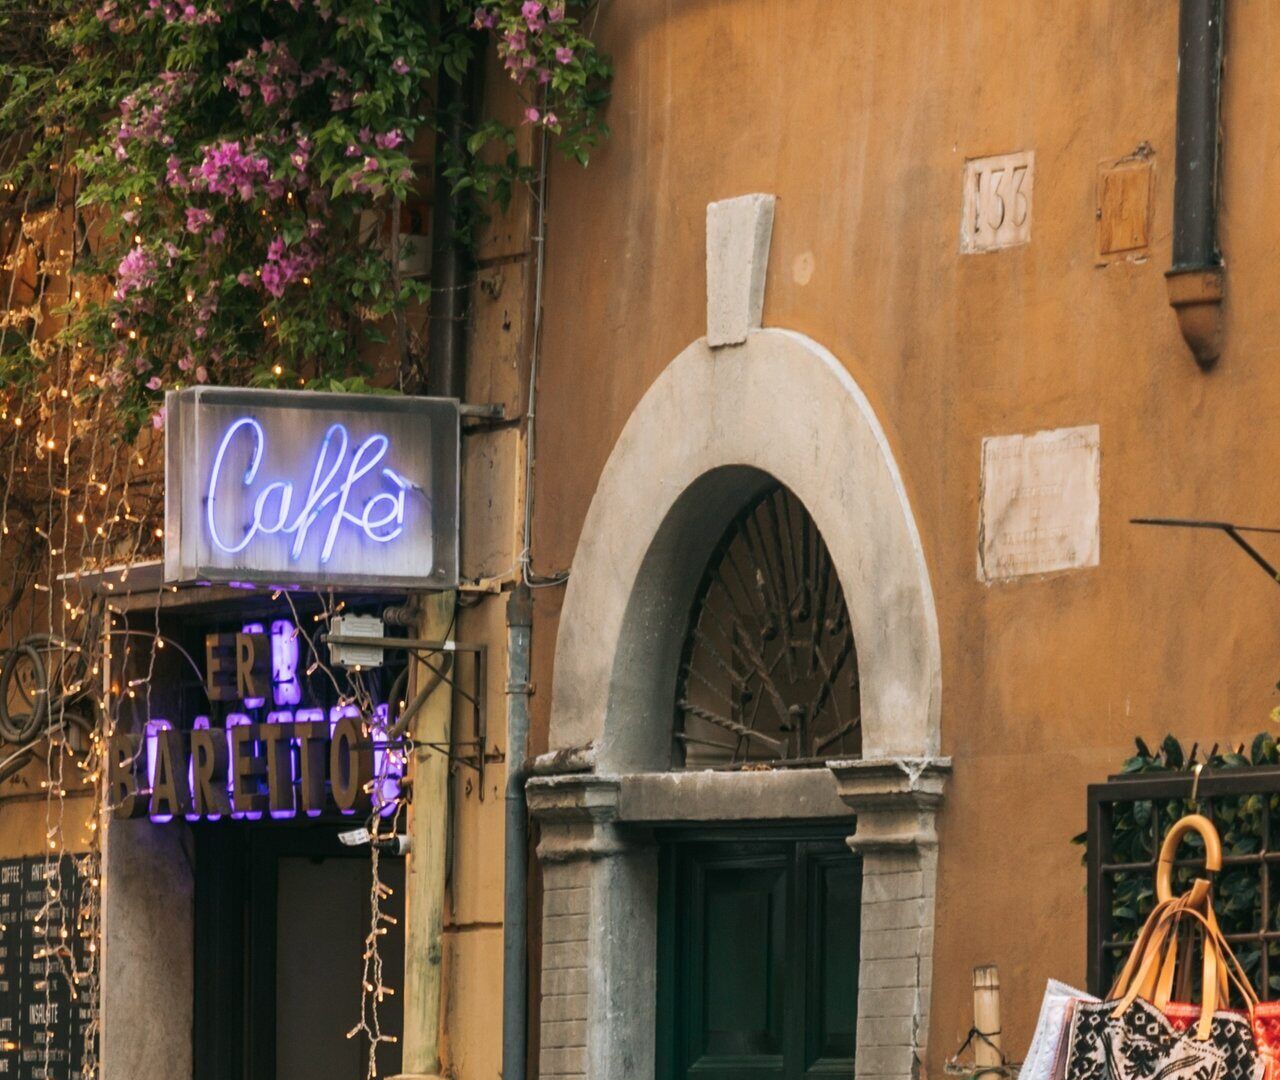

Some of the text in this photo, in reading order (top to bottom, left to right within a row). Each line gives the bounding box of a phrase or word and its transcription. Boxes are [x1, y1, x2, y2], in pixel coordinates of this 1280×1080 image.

[974, 165, 1029, 233] 133
[207, 417, 408, 563] Caffè
[206, 632, 262, 700] ER
[109, 717, 366, 818] BARETTO
[1, 865, 20, 884] COFFEE
